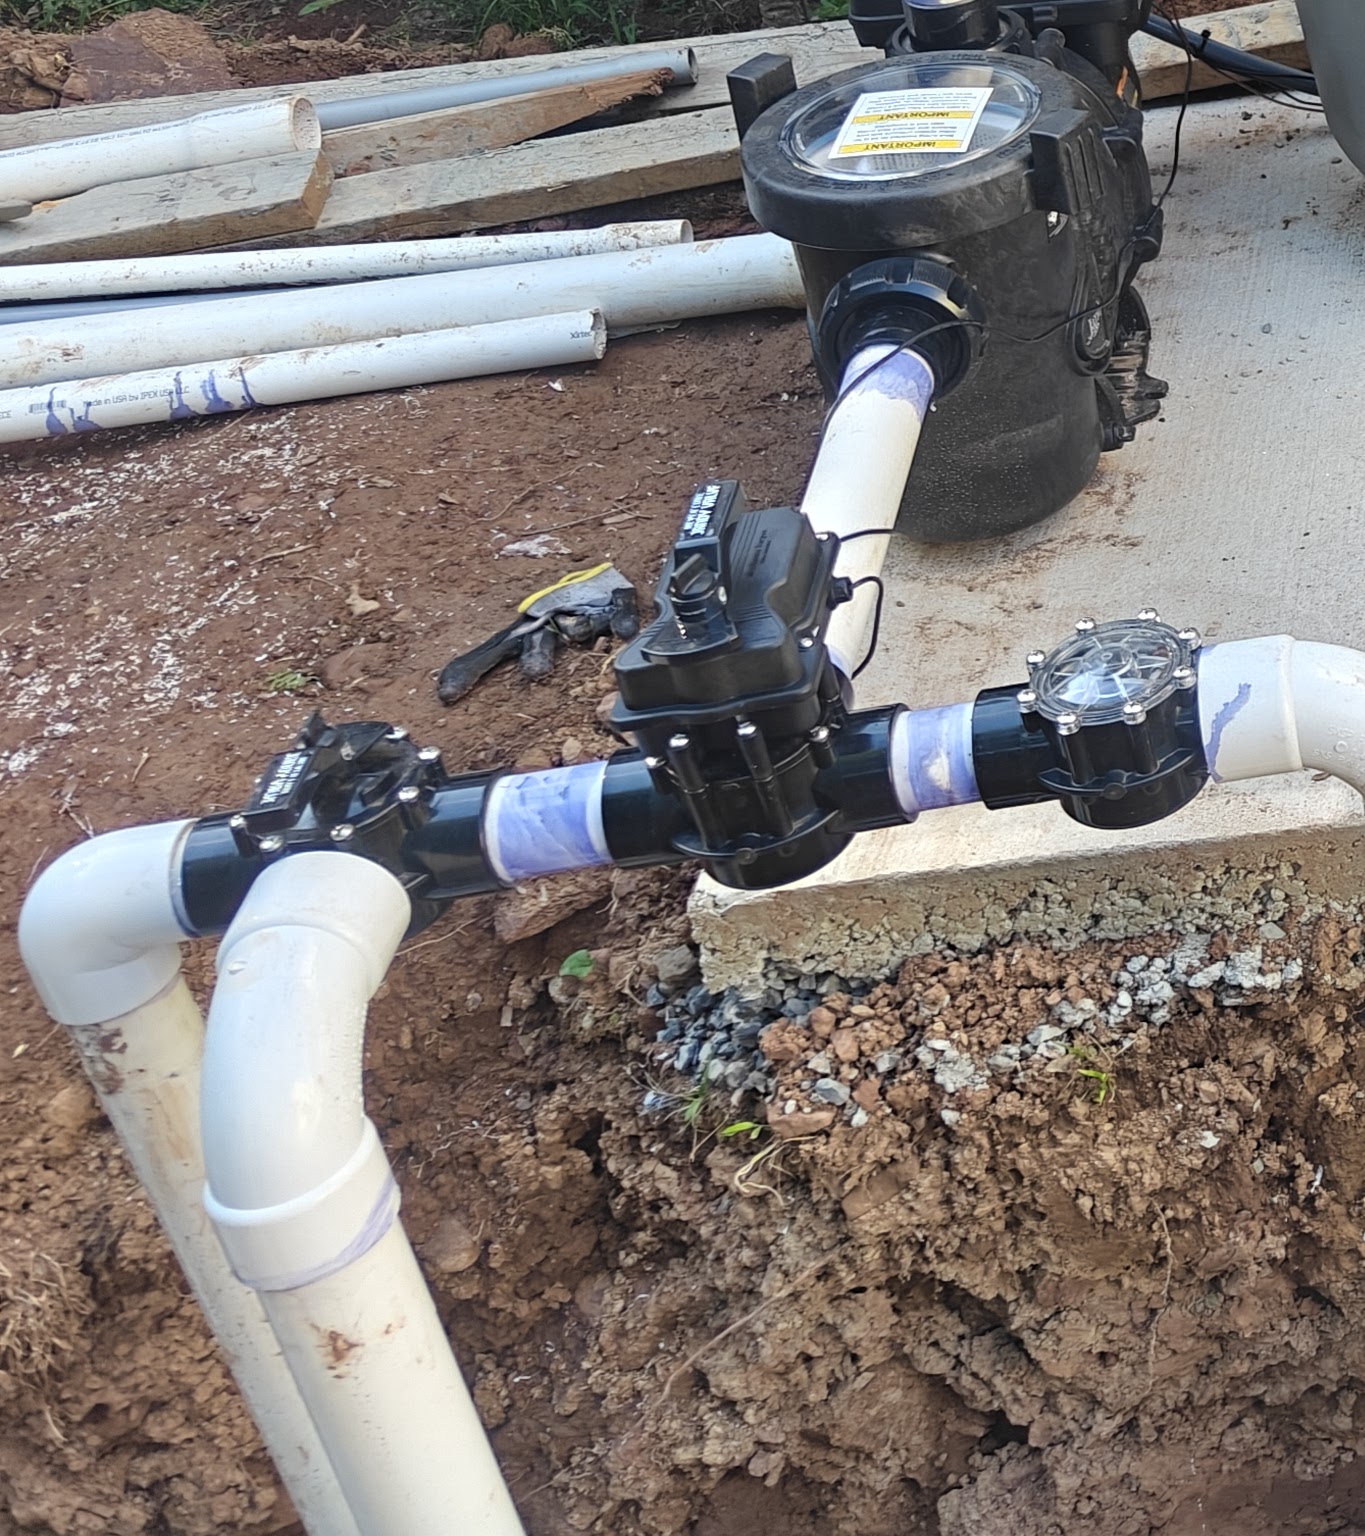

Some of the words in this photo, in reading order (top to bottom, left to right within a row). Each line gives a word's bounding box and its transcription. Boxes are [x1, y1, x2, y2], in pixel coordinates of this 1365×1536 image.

[879, 111, 950, 121] IMPORTANT
[863, 141, 937, 151] IMPORTANT
[112, 395, 127, 403] USA
